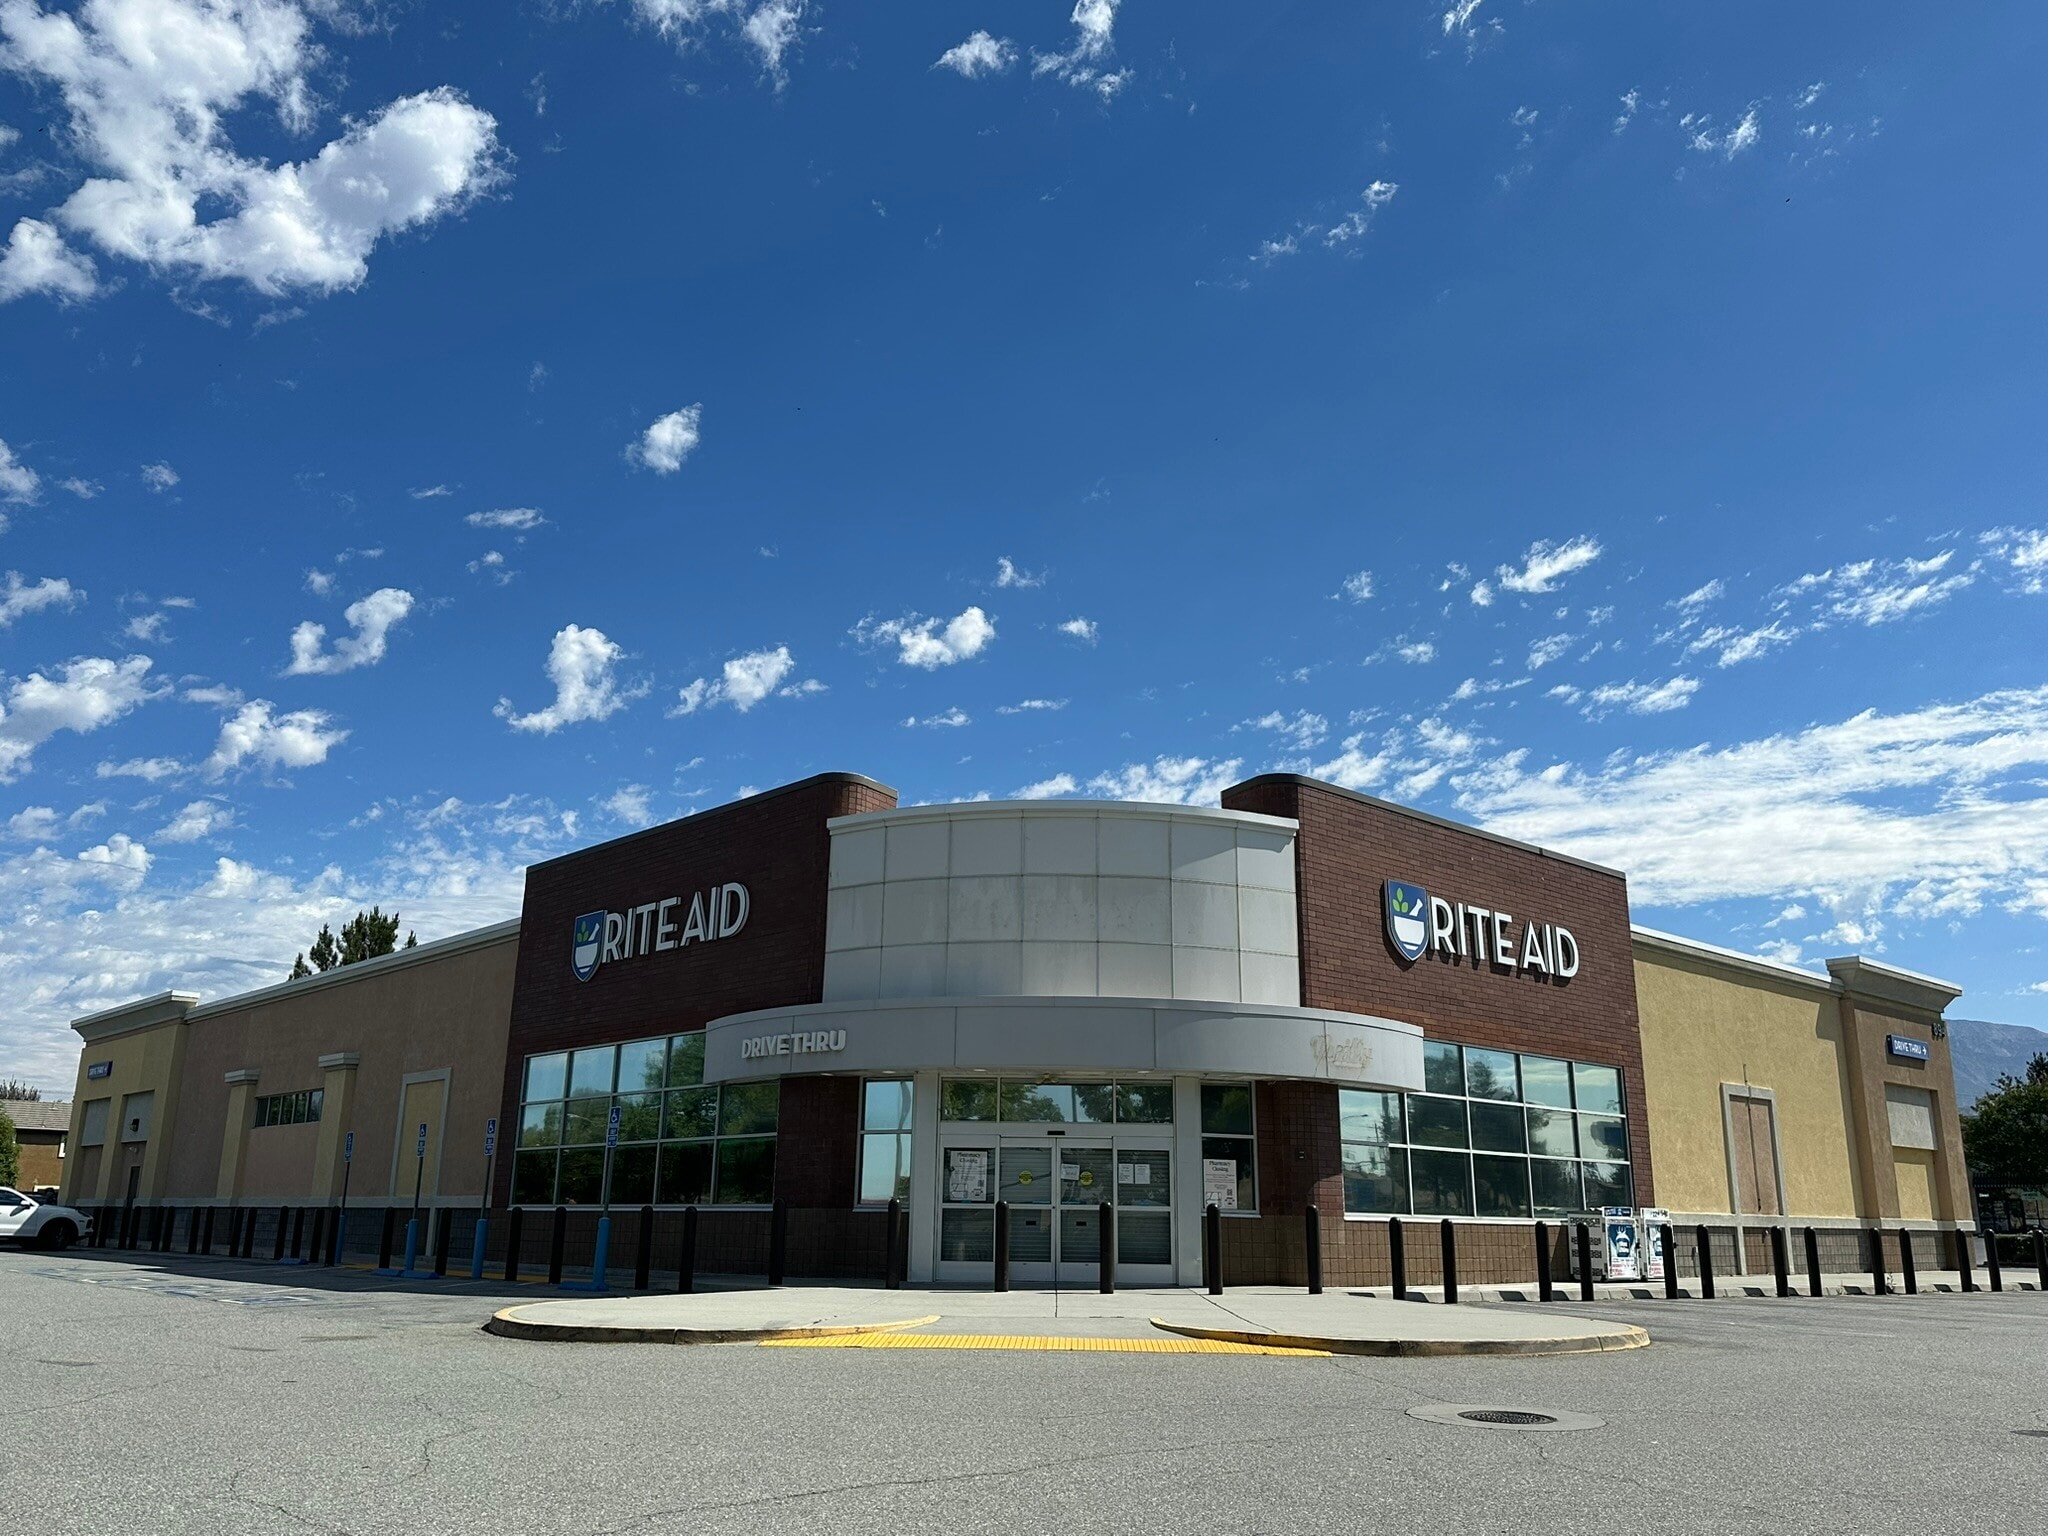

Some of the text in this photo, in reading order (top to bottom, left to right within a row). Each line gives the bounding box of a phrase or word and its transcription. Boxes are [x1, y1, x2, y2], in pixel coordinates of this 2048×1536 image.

[602, 882, 749, 963] RITE AID
[1429, 896, 1580, 978] RITE AID
[741, 1029, 846, 1059] DRIVE THRU
[1893, 1039, 1922, 1055] DRIVE THRU
